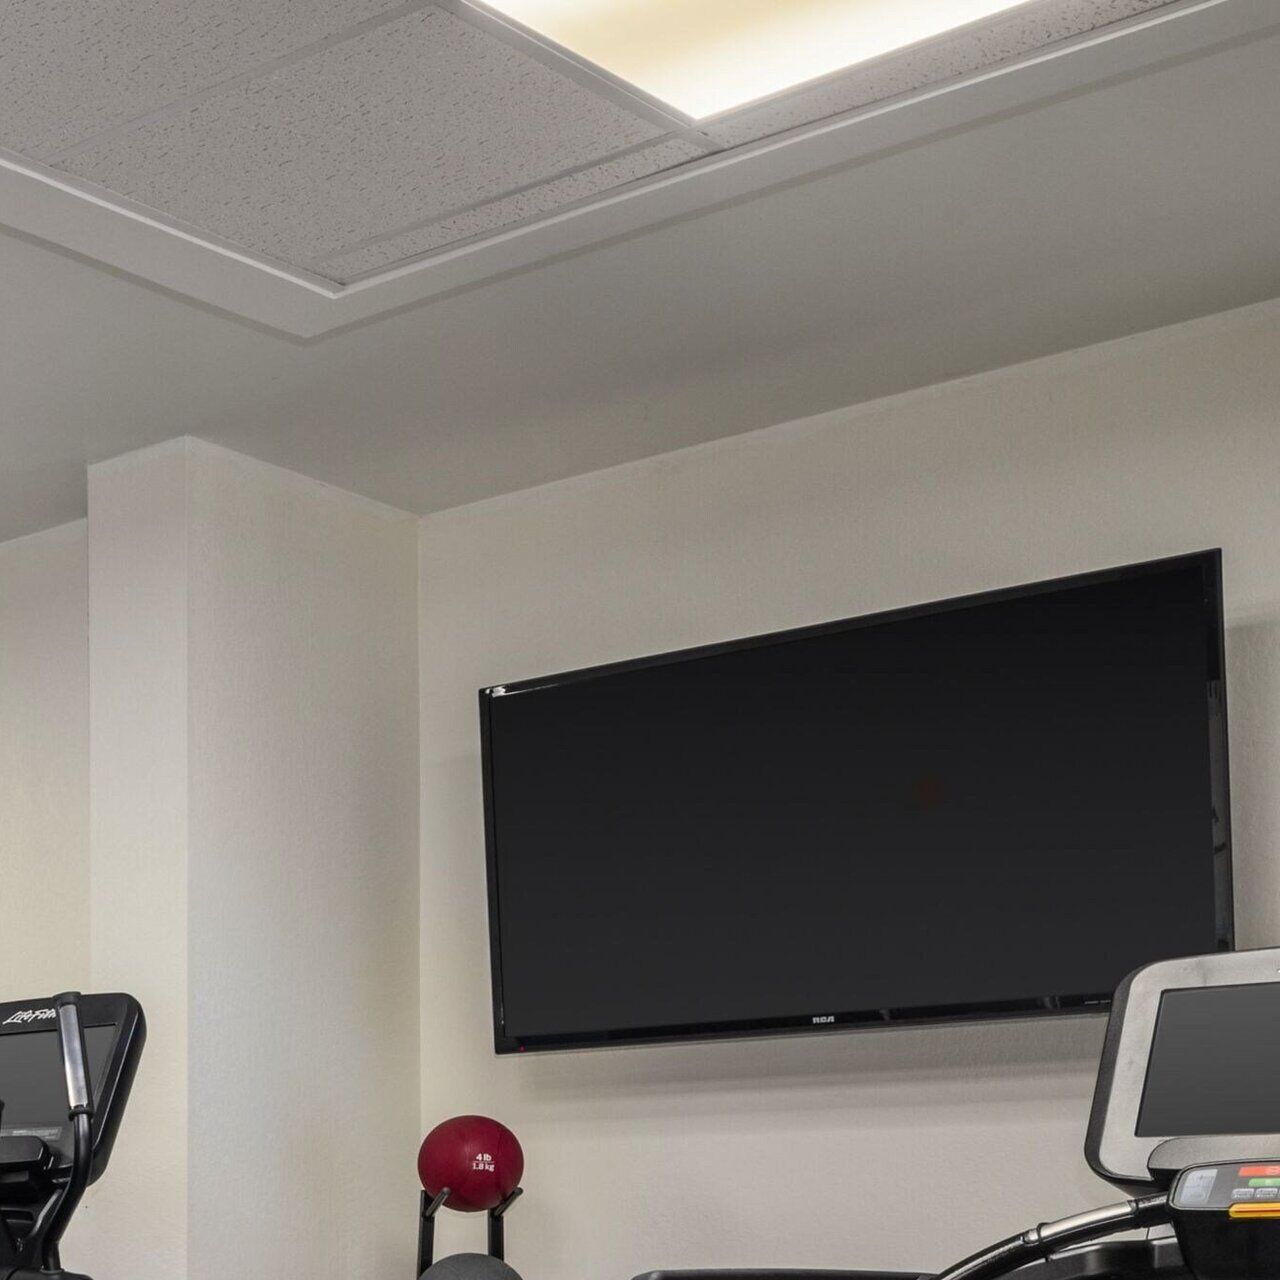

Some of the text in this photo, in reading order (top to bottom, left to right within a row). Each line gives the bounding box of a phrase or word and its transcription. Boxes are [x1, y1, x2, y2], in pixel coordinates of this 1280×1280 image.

[812, 1015, 835, 1024] RCA
[476, 1153, 492, 1161] 4 lb
[472, 1162, 495, 1172] 1.8 kg
